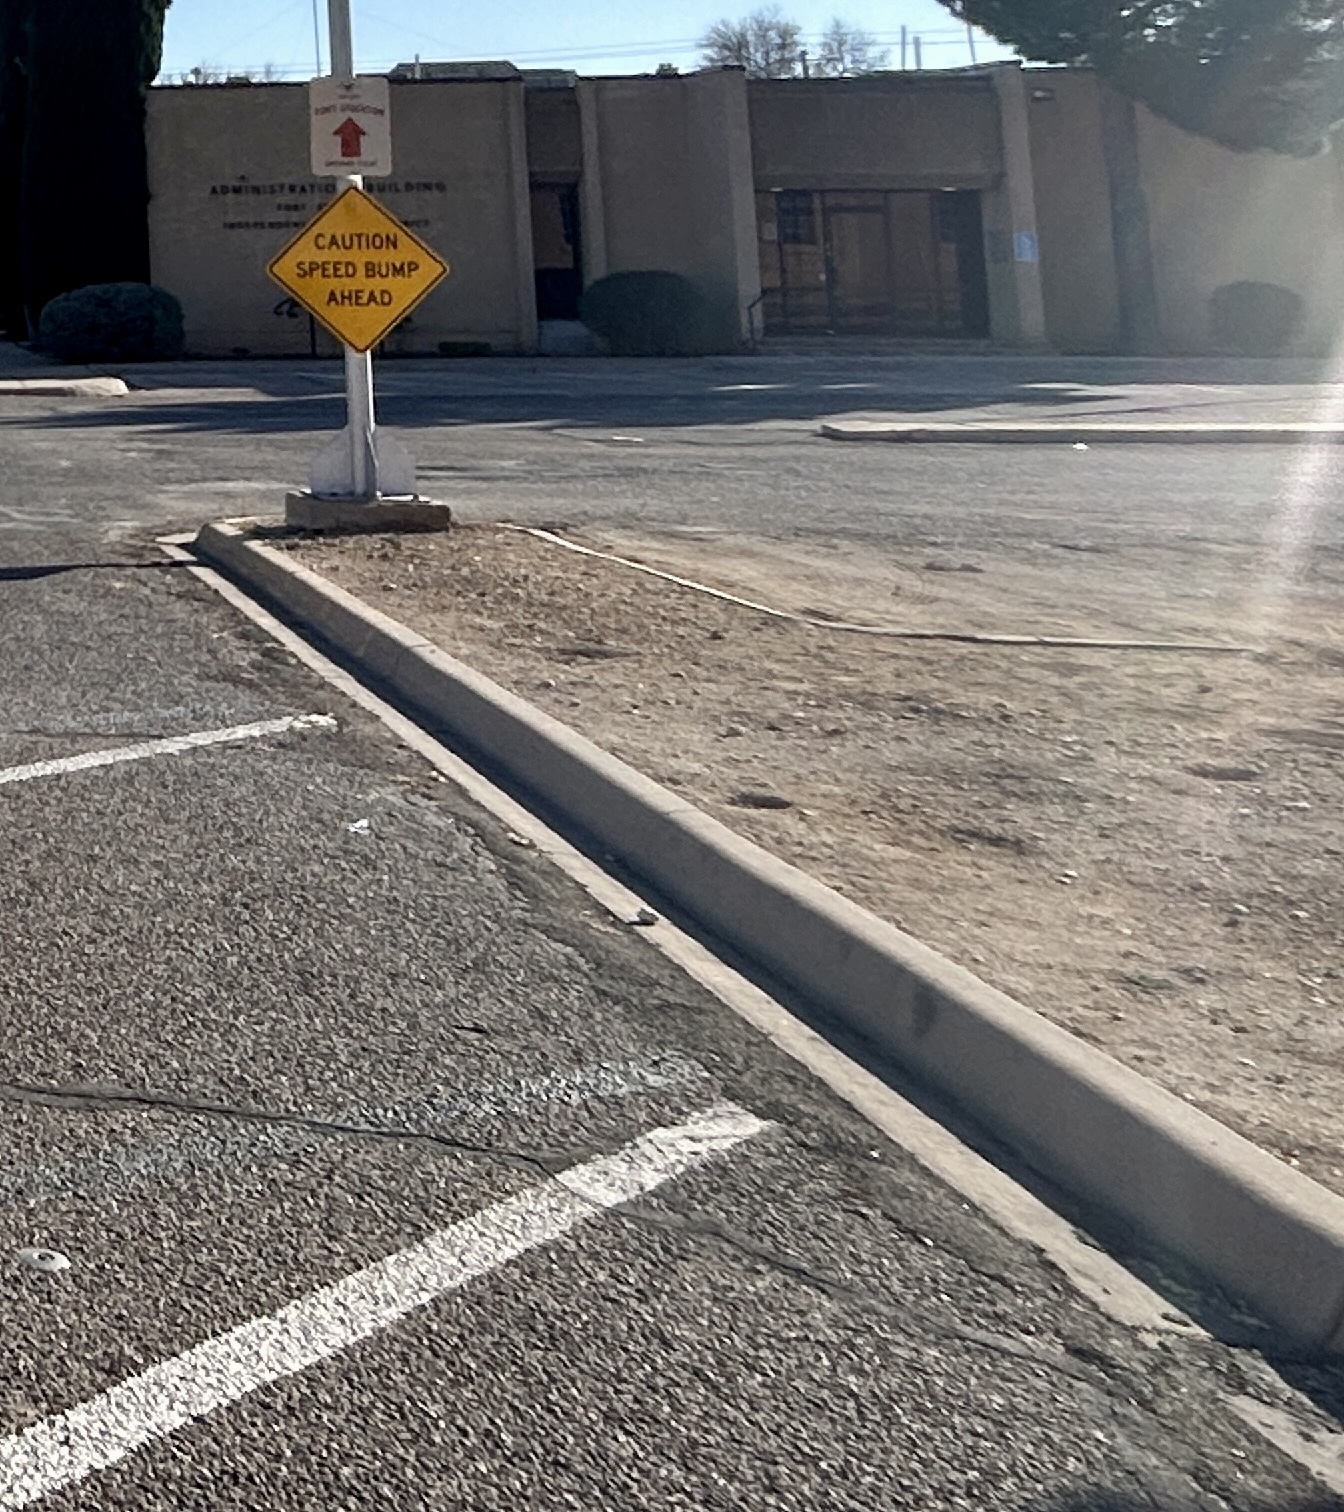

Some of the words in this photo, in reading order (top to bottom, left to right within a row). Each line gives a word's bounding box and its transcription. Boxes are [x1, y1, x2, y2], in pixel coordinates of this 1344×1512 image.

[210, 182, 336, 196] ADMINISTRATIO
[366, 181, 447, 193] BUILDING
[314, 232, 398, 250] CAUTION
[296, 260, 357, 278] SPEED
[364, 260, 419, 278] BUMP
[327, 289, 393, 306] AHEAD
